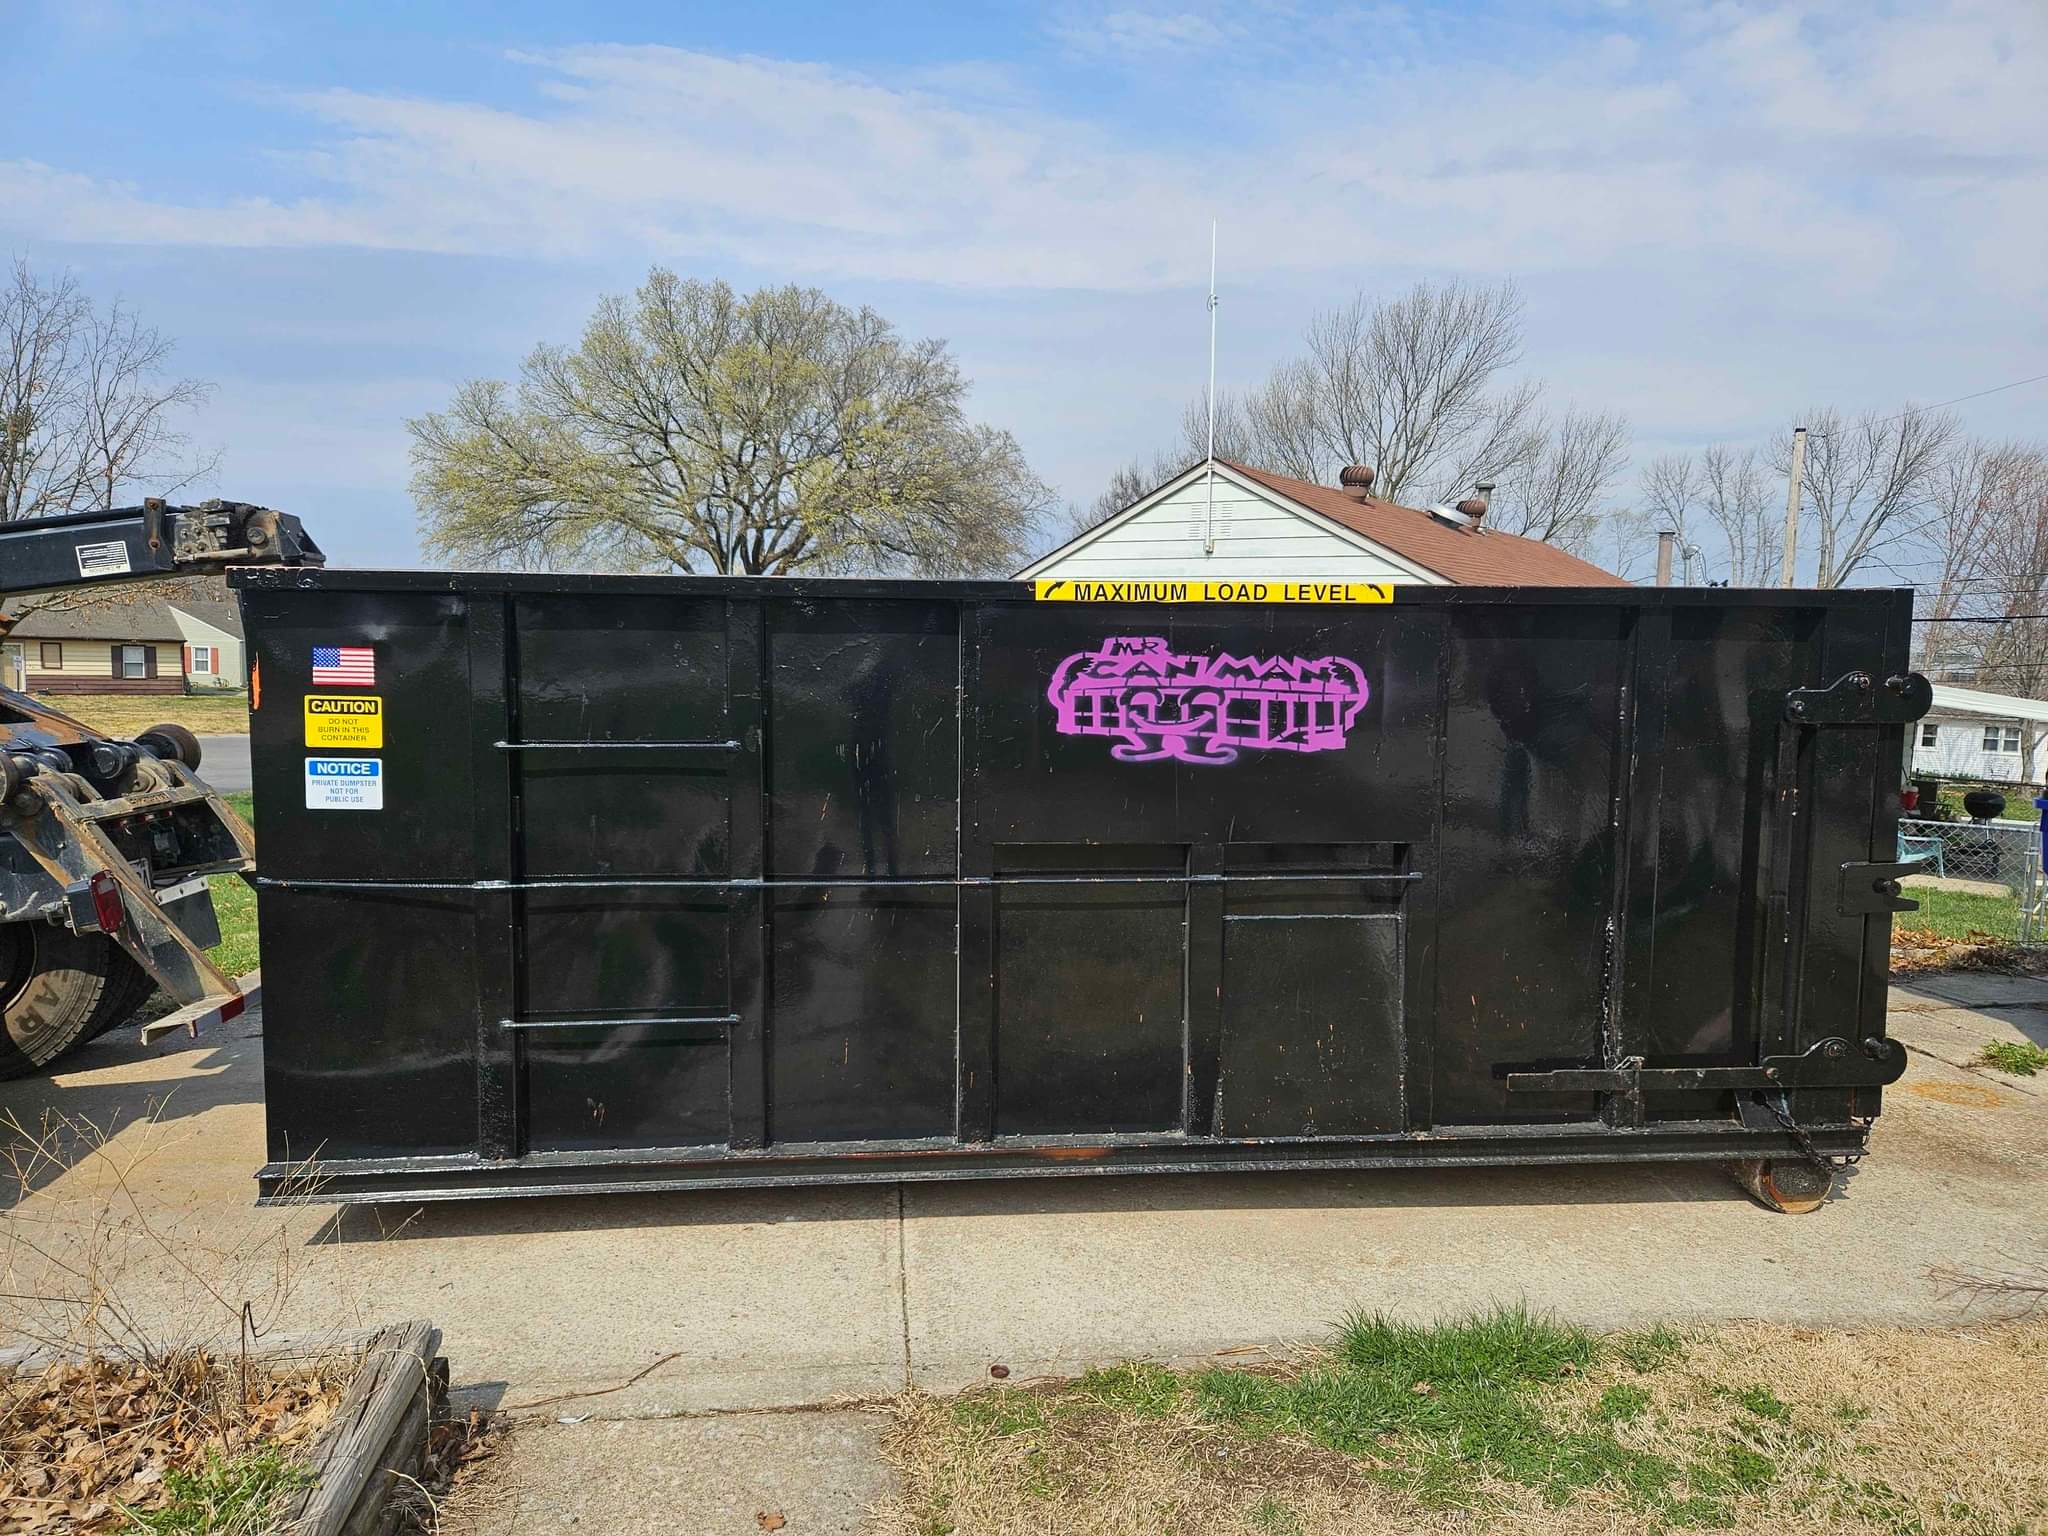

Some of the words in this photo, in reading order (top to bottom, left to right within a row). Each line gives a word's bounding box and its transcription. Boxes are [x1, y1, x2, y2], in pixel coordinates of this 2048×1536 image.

[1074, 584, 1188, 600] MAXIMUM
[1204, 584, 1268, 601] LOAD
[1284, 584, 1356, 601] LEVEL
[311, 700, 376, 713] CAUTION
[317, 763, 372, 775] NOTICE
[312, 779, 338, 787] PRIVATE
